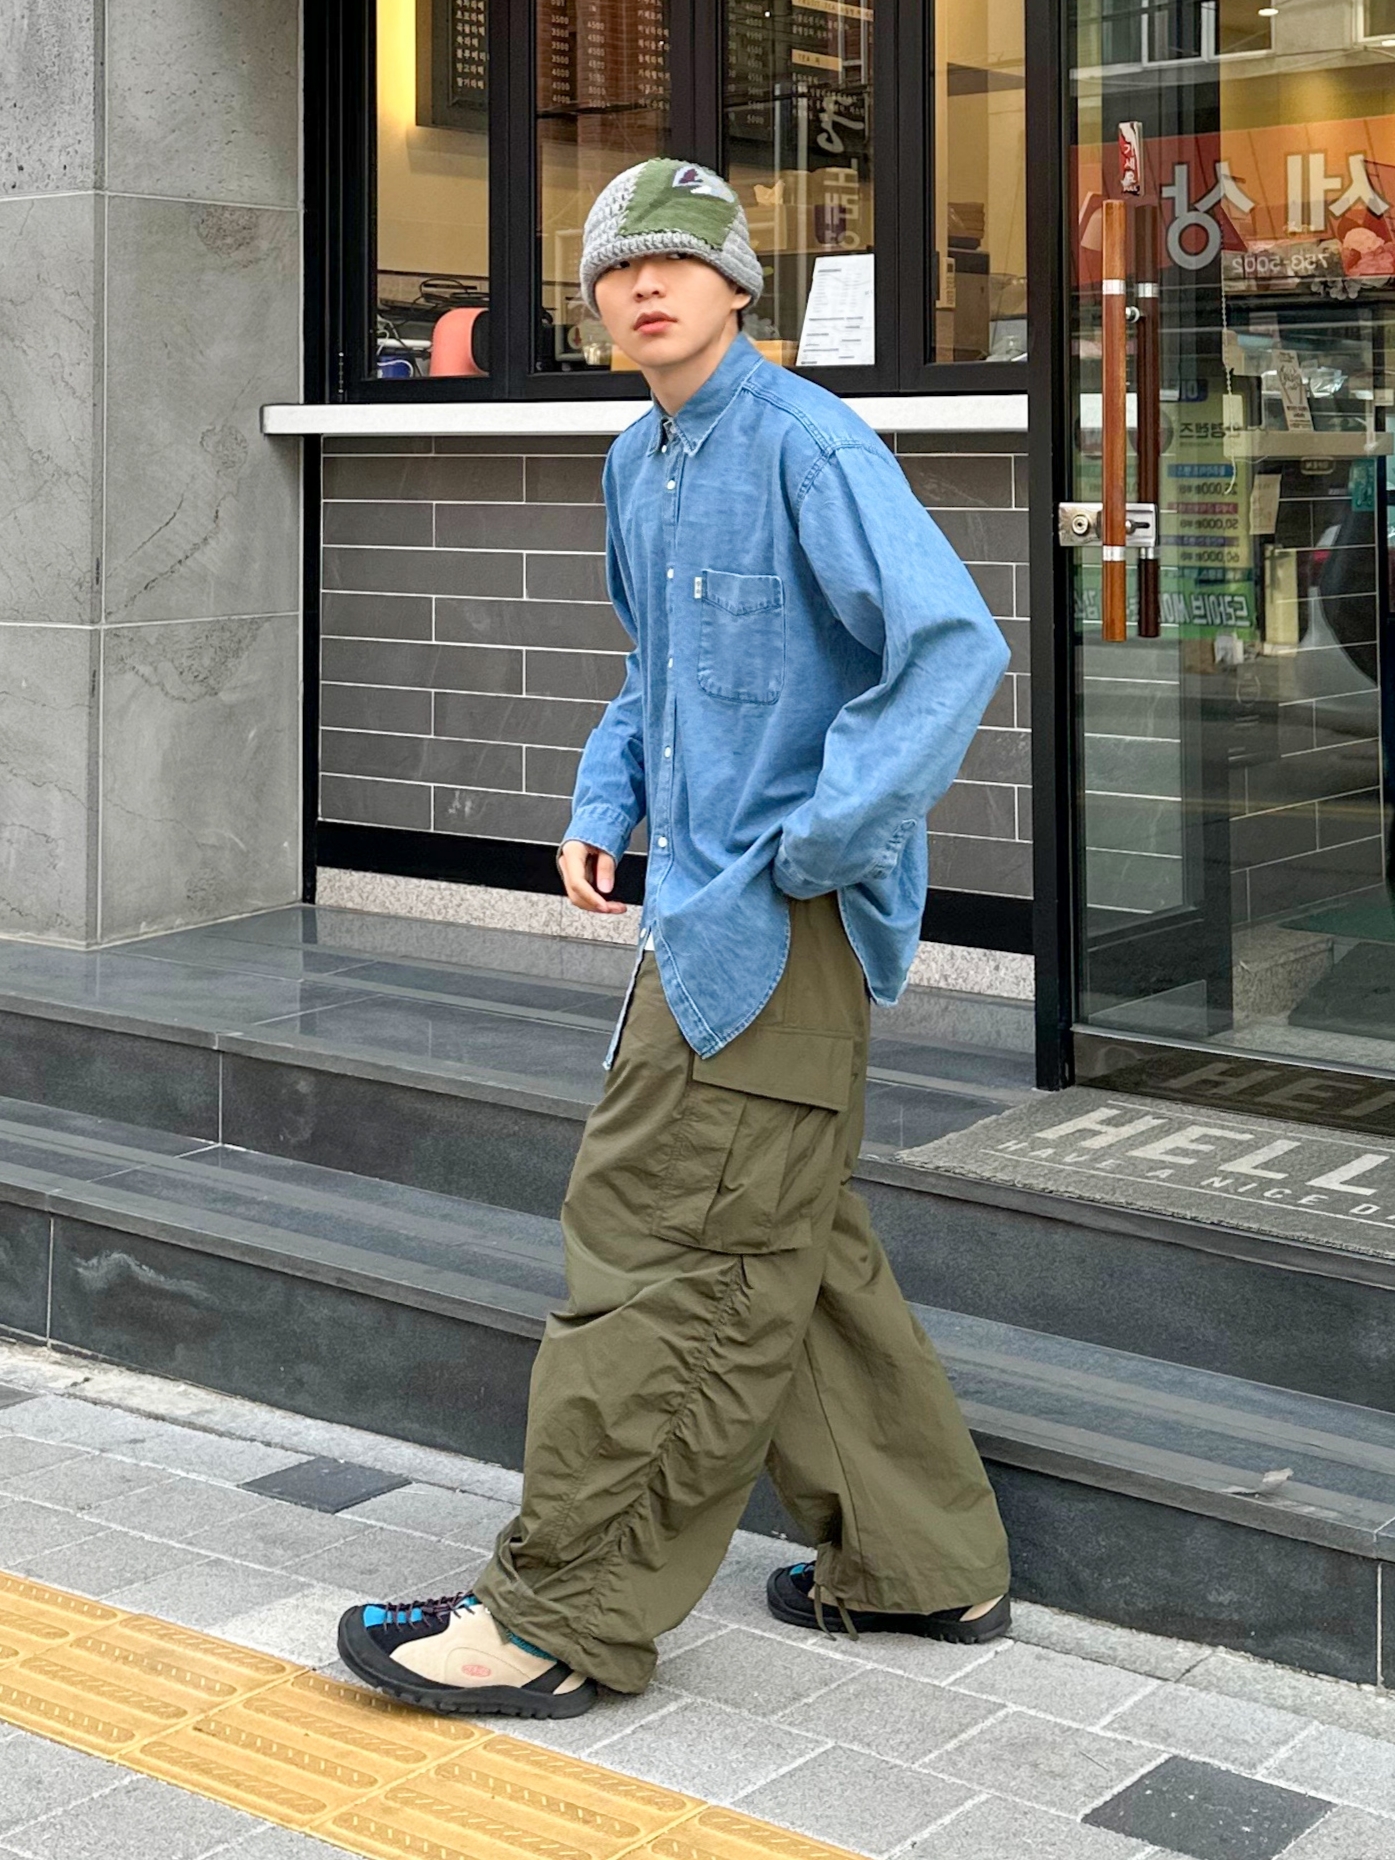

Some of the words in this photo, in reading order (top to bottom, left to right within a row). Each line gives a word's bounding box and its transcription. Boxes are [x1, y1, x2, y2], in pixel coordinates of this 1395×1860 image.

[456, 48, 490, 62] 블루베리
[996, 1140, 1124, 1169] HAVE
[1145, 1169, 1175, 1178] A
[1200, 1176, 1329, 1205] NICE
[1349, 1203, 1395, 1220] D
